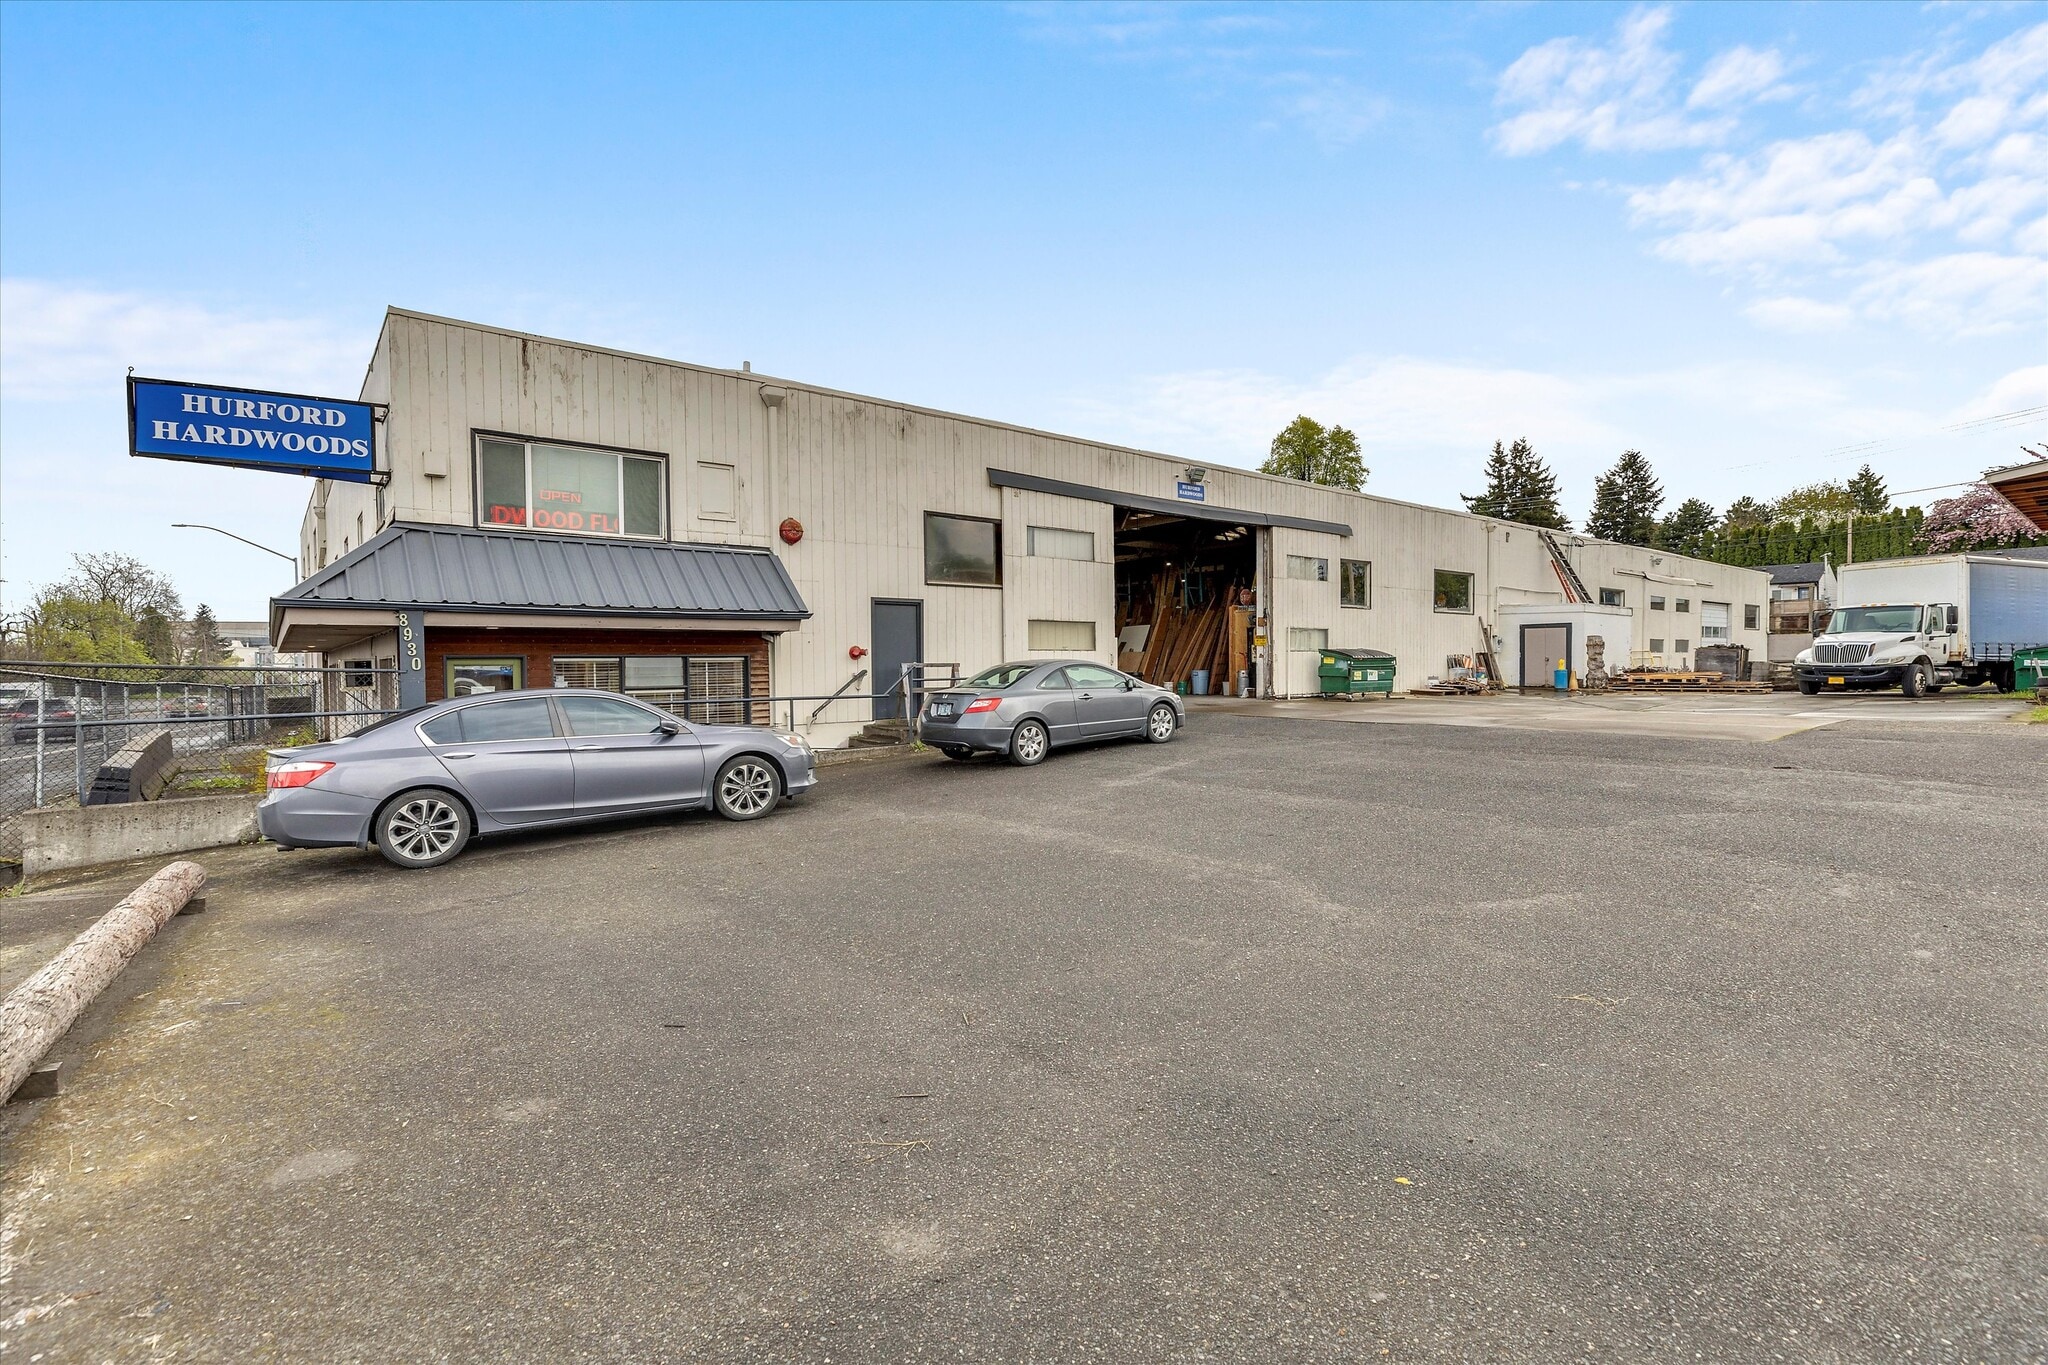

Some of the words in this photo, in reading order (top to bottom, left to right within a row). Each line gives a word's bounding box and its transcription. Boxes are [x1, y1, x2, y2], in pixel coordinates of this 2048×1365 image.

[181, 393, 346, 427] HURFORD
[152, 420, 369, 457] HARDWOODS
[540, 489, 582, 504] OPEN
[399, 613, 422, 671] 8930
